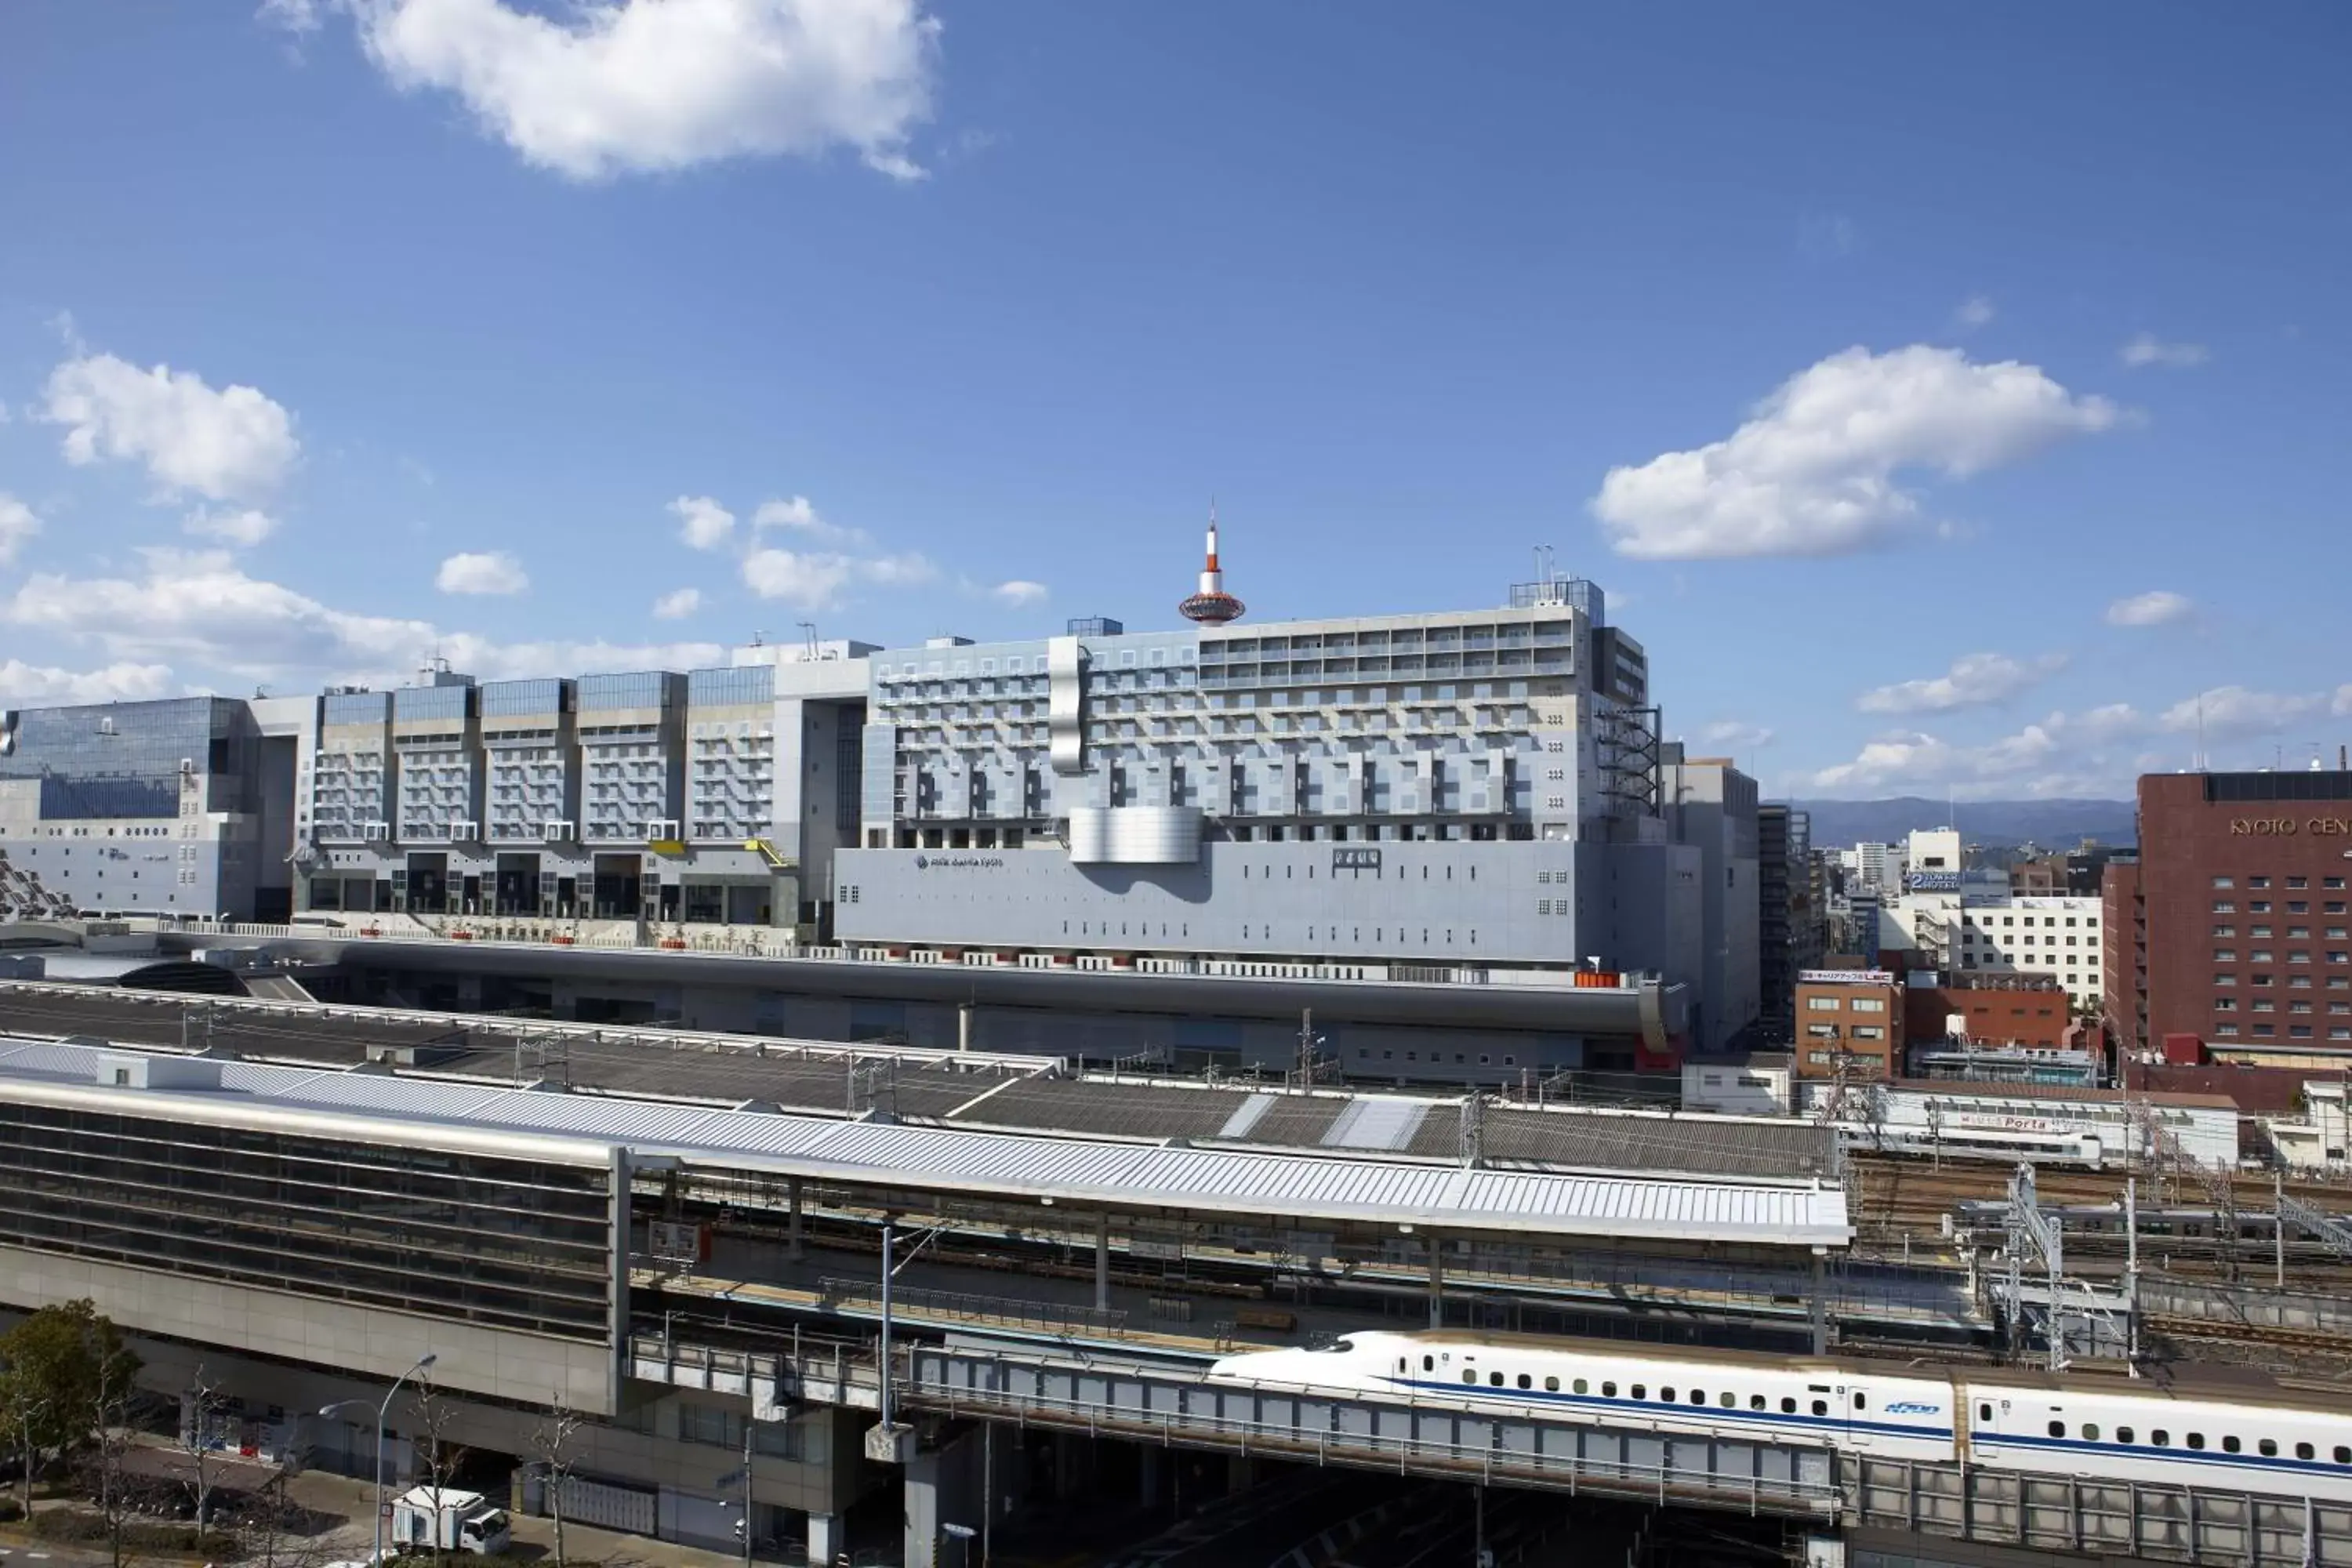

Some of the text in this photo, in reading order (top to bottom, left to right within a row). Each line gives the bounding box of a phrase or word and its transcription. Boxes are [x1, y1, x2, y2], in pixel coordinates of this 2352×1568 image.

[2230, 818, 2352, 836] KYOTO CEN
[2005, 1116, 2046, 1130] Porta
